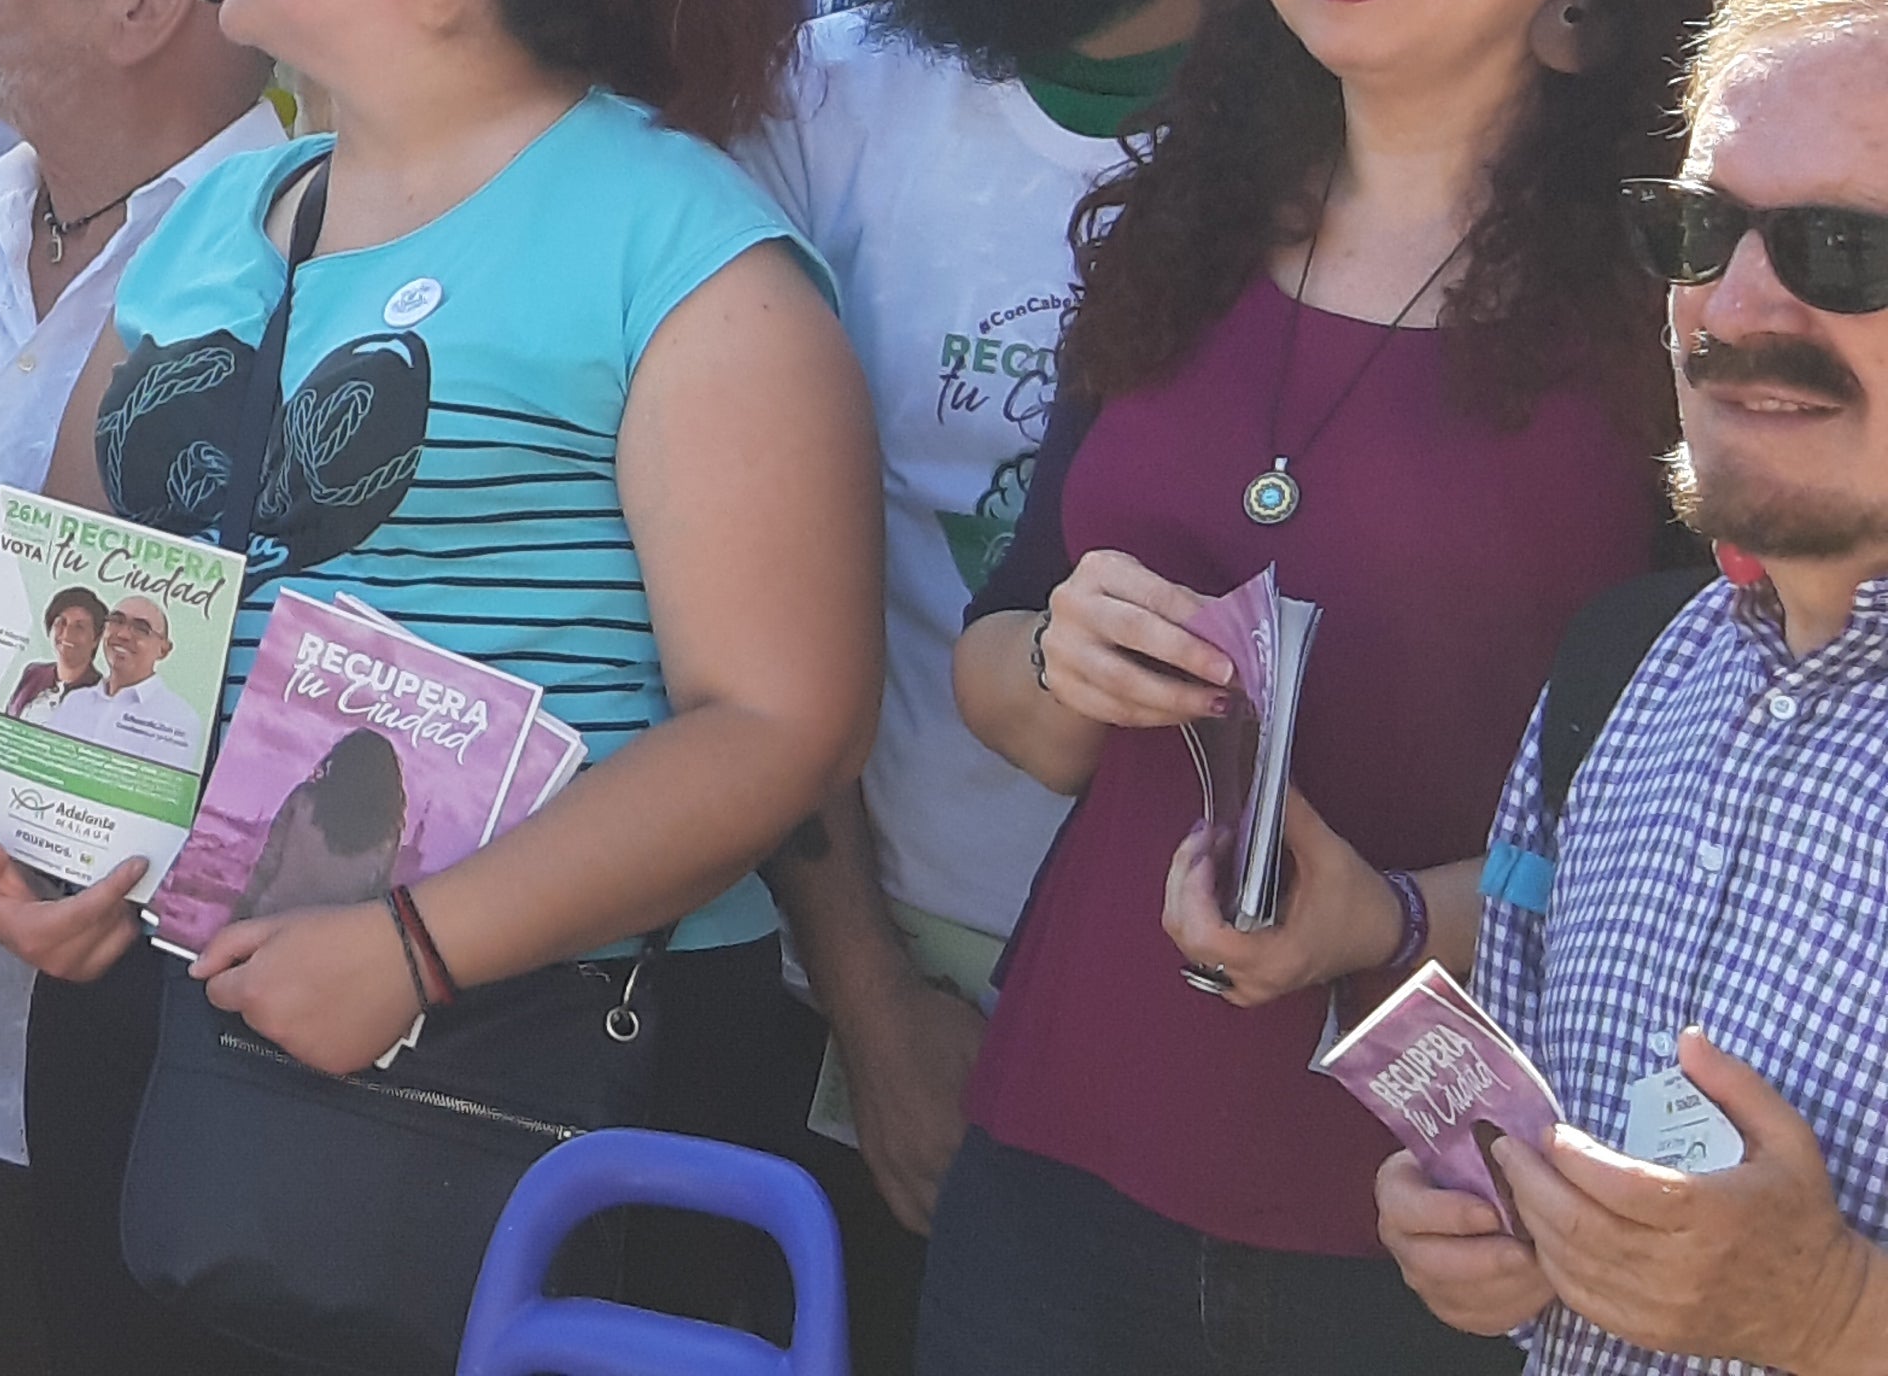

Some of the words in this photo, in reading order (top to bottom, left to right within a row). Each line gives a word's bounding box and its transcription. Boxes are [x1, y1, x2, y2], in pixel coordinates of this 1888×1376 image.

[0, 535, 44, 563] VOTA
[5, 500, 52, 529] 26M
[58, 515, 225, 581] RECUPERA
[97, 547, 227, 621] Ciudad
[297, 632, 489, 726] RECUPERA
[337, 674, 489, 766] Ciudad
[55, 801, 116, 832] Adelante
[1368, 1024, 1470, 1110] RECUPERA
[1421, 1043, 1512, 1126] Ciudad
